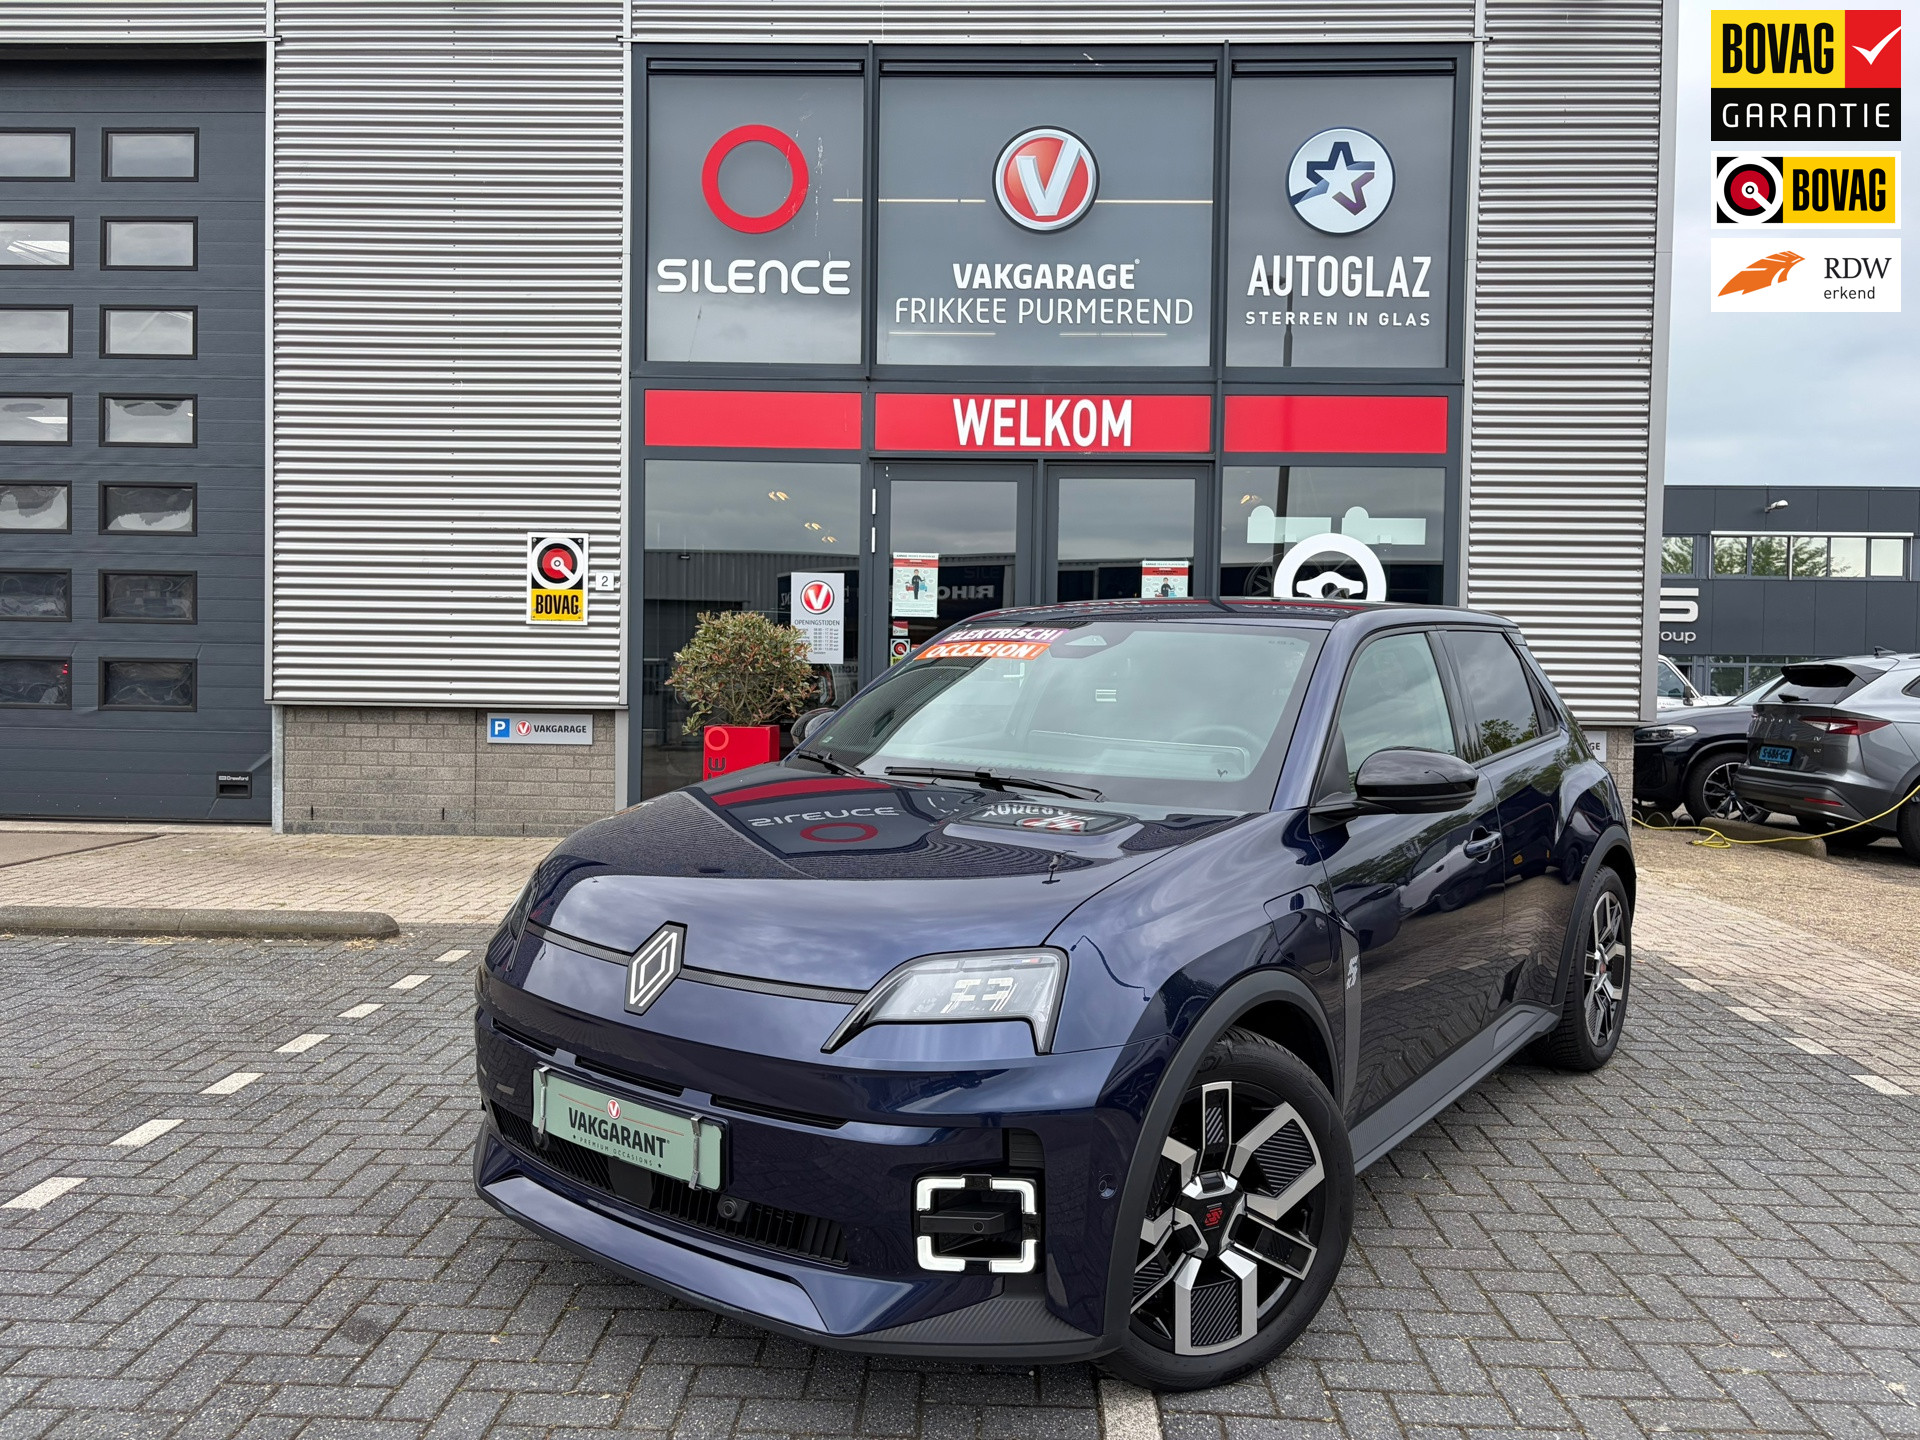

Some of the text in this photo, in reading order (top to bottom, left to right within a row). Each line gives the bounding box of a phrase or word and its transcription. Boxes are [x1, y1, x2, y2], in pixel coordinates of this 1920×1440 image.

[657, 258, 851, 296] SILENCE
[1247, 255, 1432, 299] AUTOGLAZ
[896, 297, 1193, 325] FRIKKEE PURMEREND
[1245, 311, 1431, 327] STERREN IN GLAS
[953, 398, 1133, 447] WELKOM
[601, 576, 609, 587] 2
[535, 594, 579, 615] BOVAG
[1659, 631, 1697, 644] oup
[533, 724, 587, 733] VAKGARAGE
[568, 1106, 668, 1159] VAKGARANT
[579, 1137, 654, 1168] PREMIUM OCCASIONS
